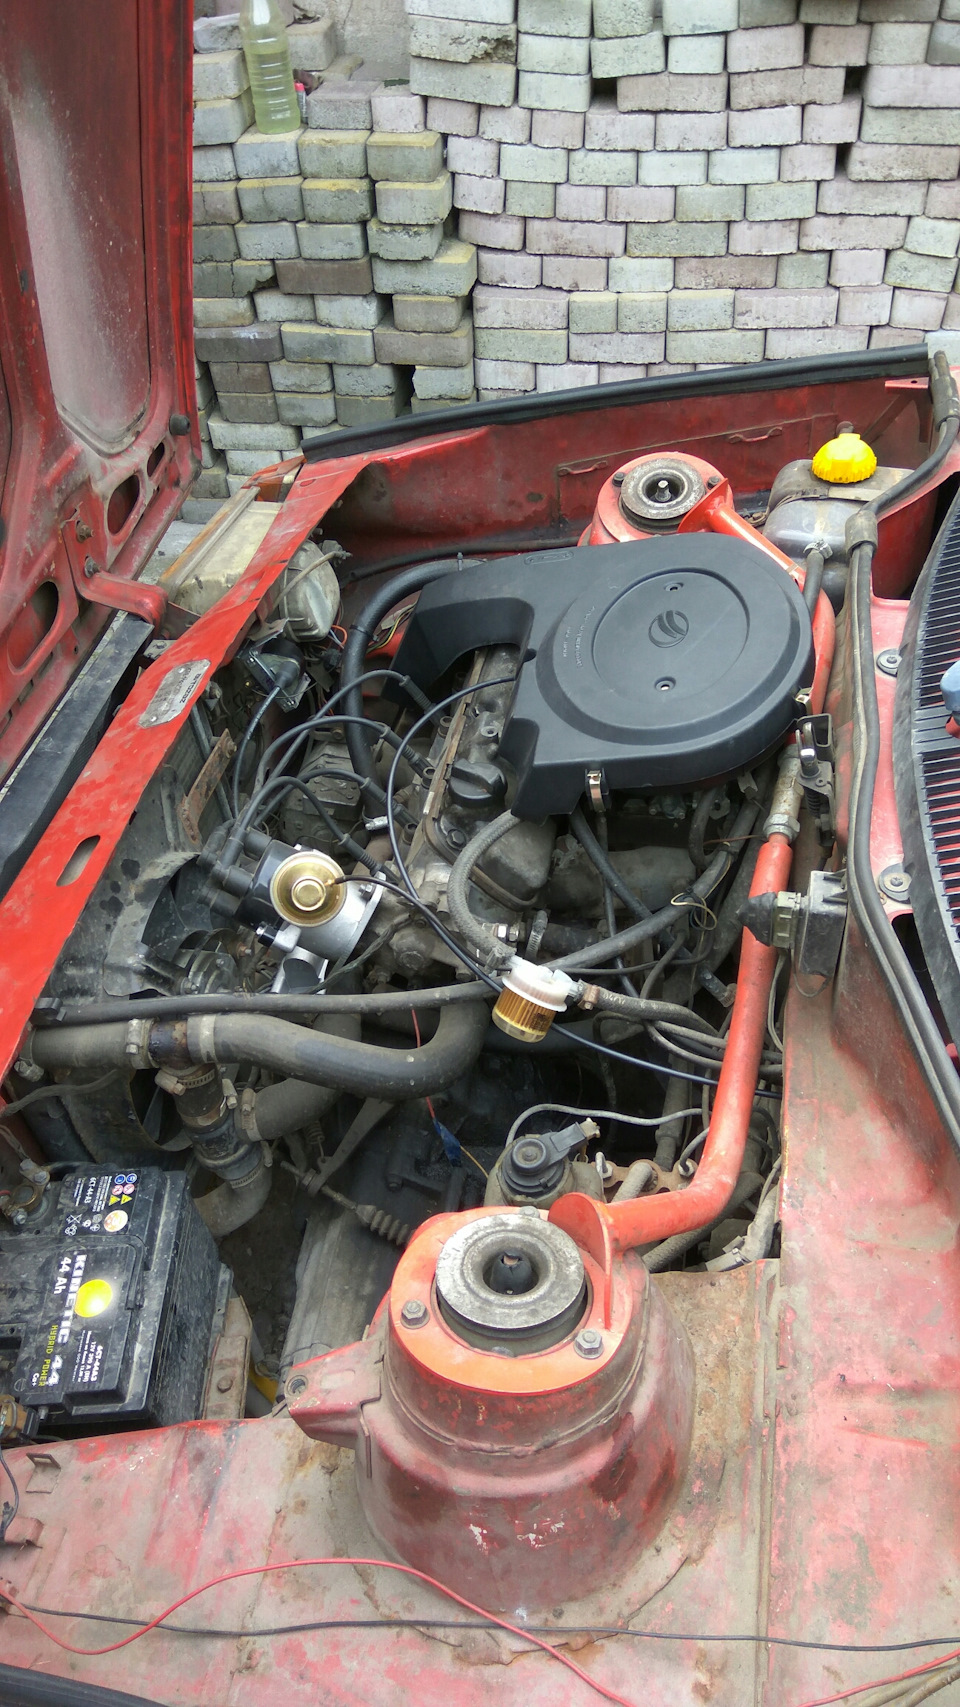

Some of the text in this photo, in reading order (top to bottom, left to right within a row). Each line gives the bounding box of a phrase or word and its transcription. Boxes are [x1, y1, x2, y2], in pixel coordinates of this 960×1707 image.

[53, 1256, 72, 1294] 44 Ah
[57, 1254, 87, 1344] KINETIC
[38, 1324, 58, 1387] HYBRID POWER
[48, 1355, 63, 1386] 44
